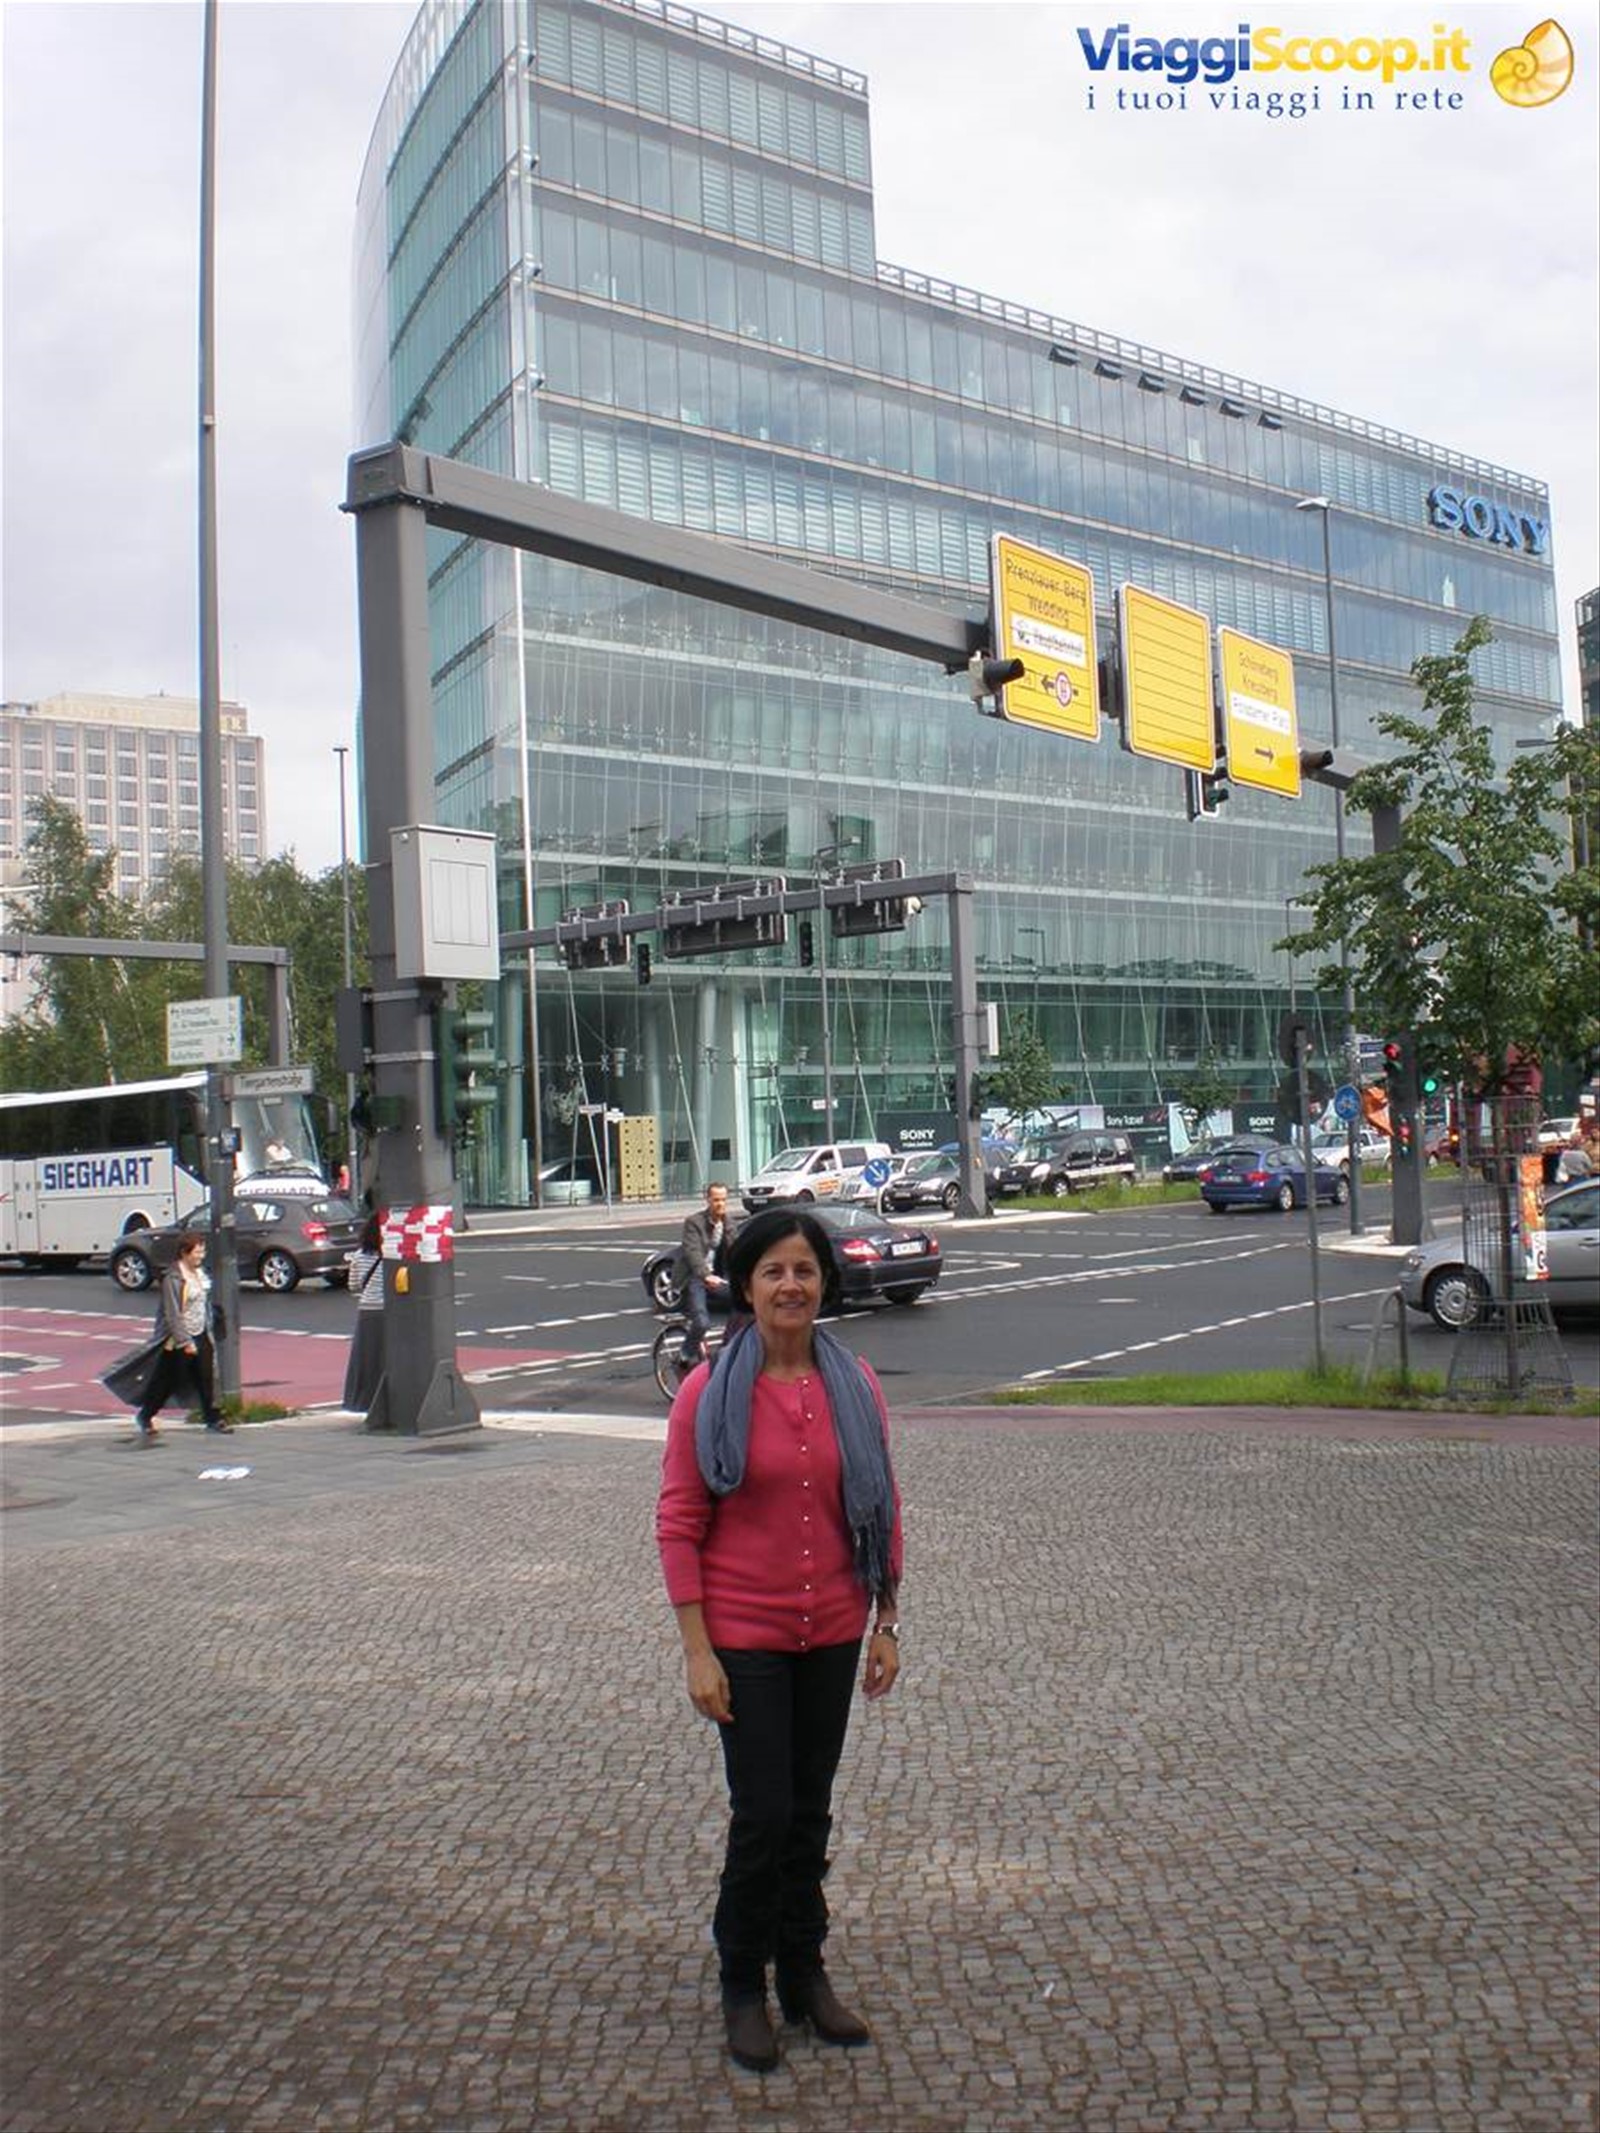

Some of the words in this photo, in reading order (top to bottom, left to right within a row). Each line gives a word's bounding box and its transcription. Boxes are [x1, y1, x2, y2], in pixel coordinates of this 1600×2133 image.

[1427, 485, 1550, 555] SONY
[1248, 1116, 1276, 1127] SONY
[899, 1129, 936, 1140] SONY
[44, 1156, 154, 1190] SIEGHART
